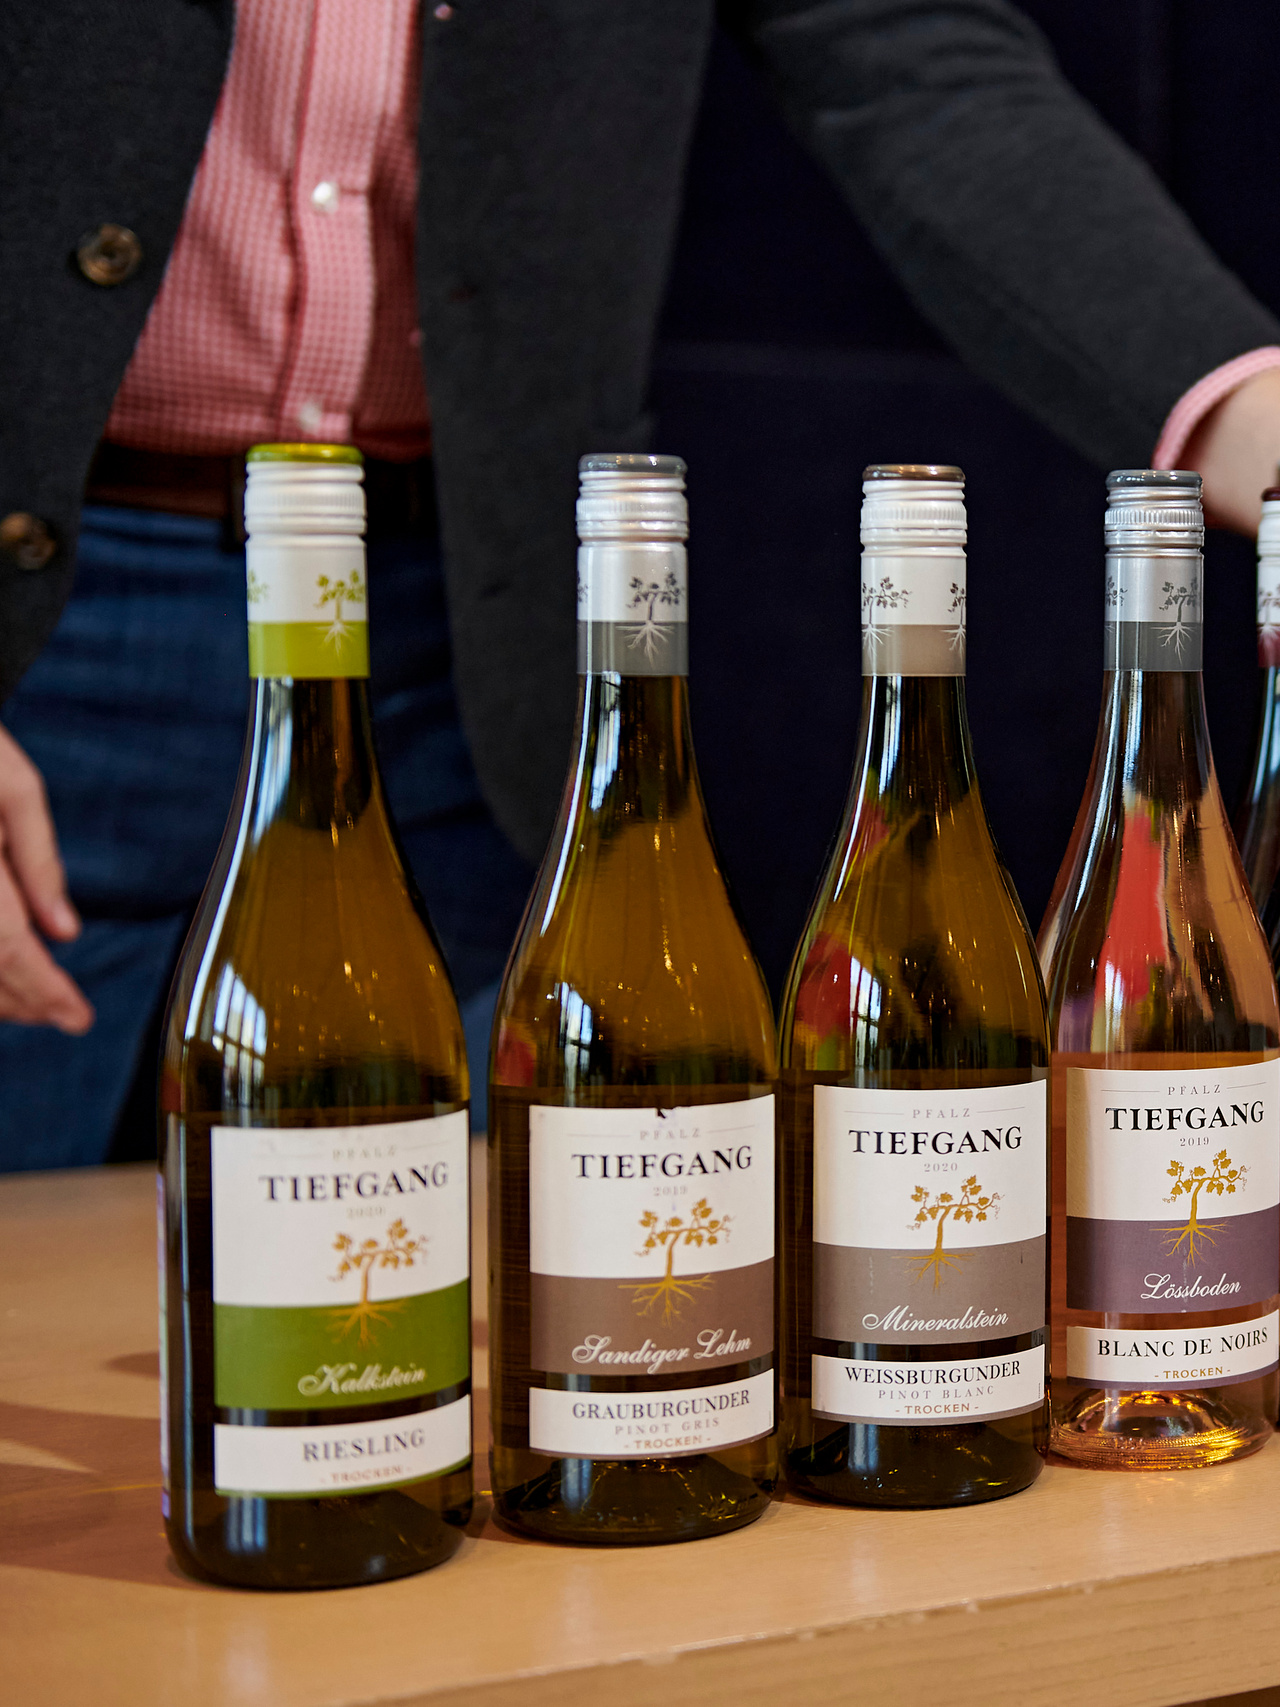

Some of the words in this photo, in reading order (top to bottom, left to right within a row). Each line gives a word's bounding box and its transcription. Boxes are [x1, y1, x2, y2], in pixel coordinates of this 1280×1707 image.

[1168, 1084, 1221, 1096] PFALZ
[912, 1108, 971, 1119] PFALZ
[1105, 1100, 1265, 1131] TIEFGANG
[640, 1128, 701, 1140] PFALZ
[849, 1125, 1022, 1155] TIEFGANG
[1179, 1136, 1210, 1147] 2019
[571, 1145, 752, 1178] TIEFGANG
[924, 1162, 959, 1172] 2020
[259, 1161, 449, 1201] TIEFGANG
[1140, 1273, 1241, 1300] Lössboden
[862, 1305, 1008, 1332] Mineralstein
[572, 1334, 689, 1374] Sandiger
[694, 1328, 752, 1360] Lehm
[1097, 1339, 1175, 1358] BLANC
[1184, 1338, 1212, 1356] DE
[1221, 1326, 1268, 1353] NOIRS
[297, 1362, 425, 1396] Kalkstein
[845, 1360, 1021, 1385] WEISSBURGUNDER
[1163, 1366, 1224, 1379] TROCKEN
[572, 1389, 750, 1419] GRAUBURGUNDER
[878, 1389, 931, 1400] PINOT
[942, 1385, 994, 1399] BLANC
[904, 1402, 971, 1415] TROCKEN
[615, 1424, 671, 1435] PINOT
[682, 1417, 719, 1431] GRIS
[302, 1428, 425, 1462] RIESLING
[634, 1436, 702, 1450] TROCKEN
[332, 1465, 402, 1483] TROCKEN
